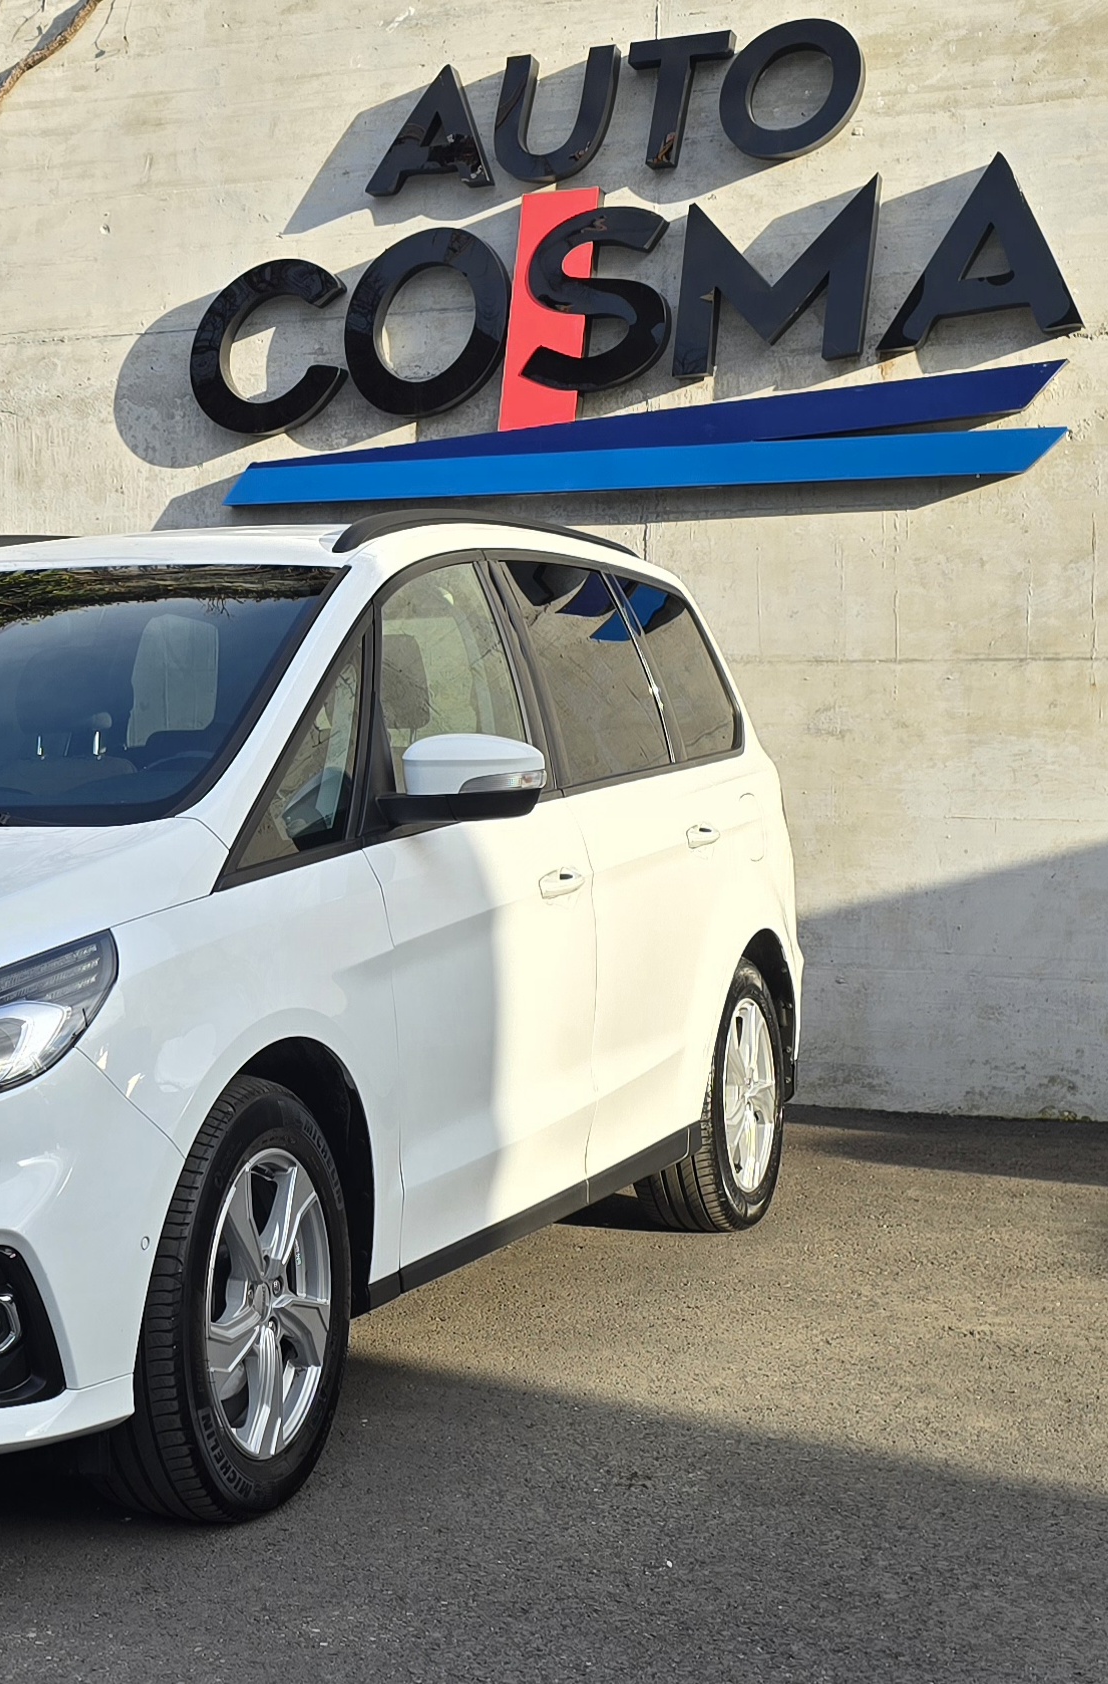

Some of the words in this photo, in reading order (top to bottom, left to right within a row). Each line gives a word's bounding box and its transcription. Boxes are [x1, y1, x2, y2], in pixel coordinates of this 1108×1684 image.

[365, 18, 866, 197] AUTO
[189, 151, 1084, 436] COSMA
[201, 1412, 252, 1499] MICHELIN
